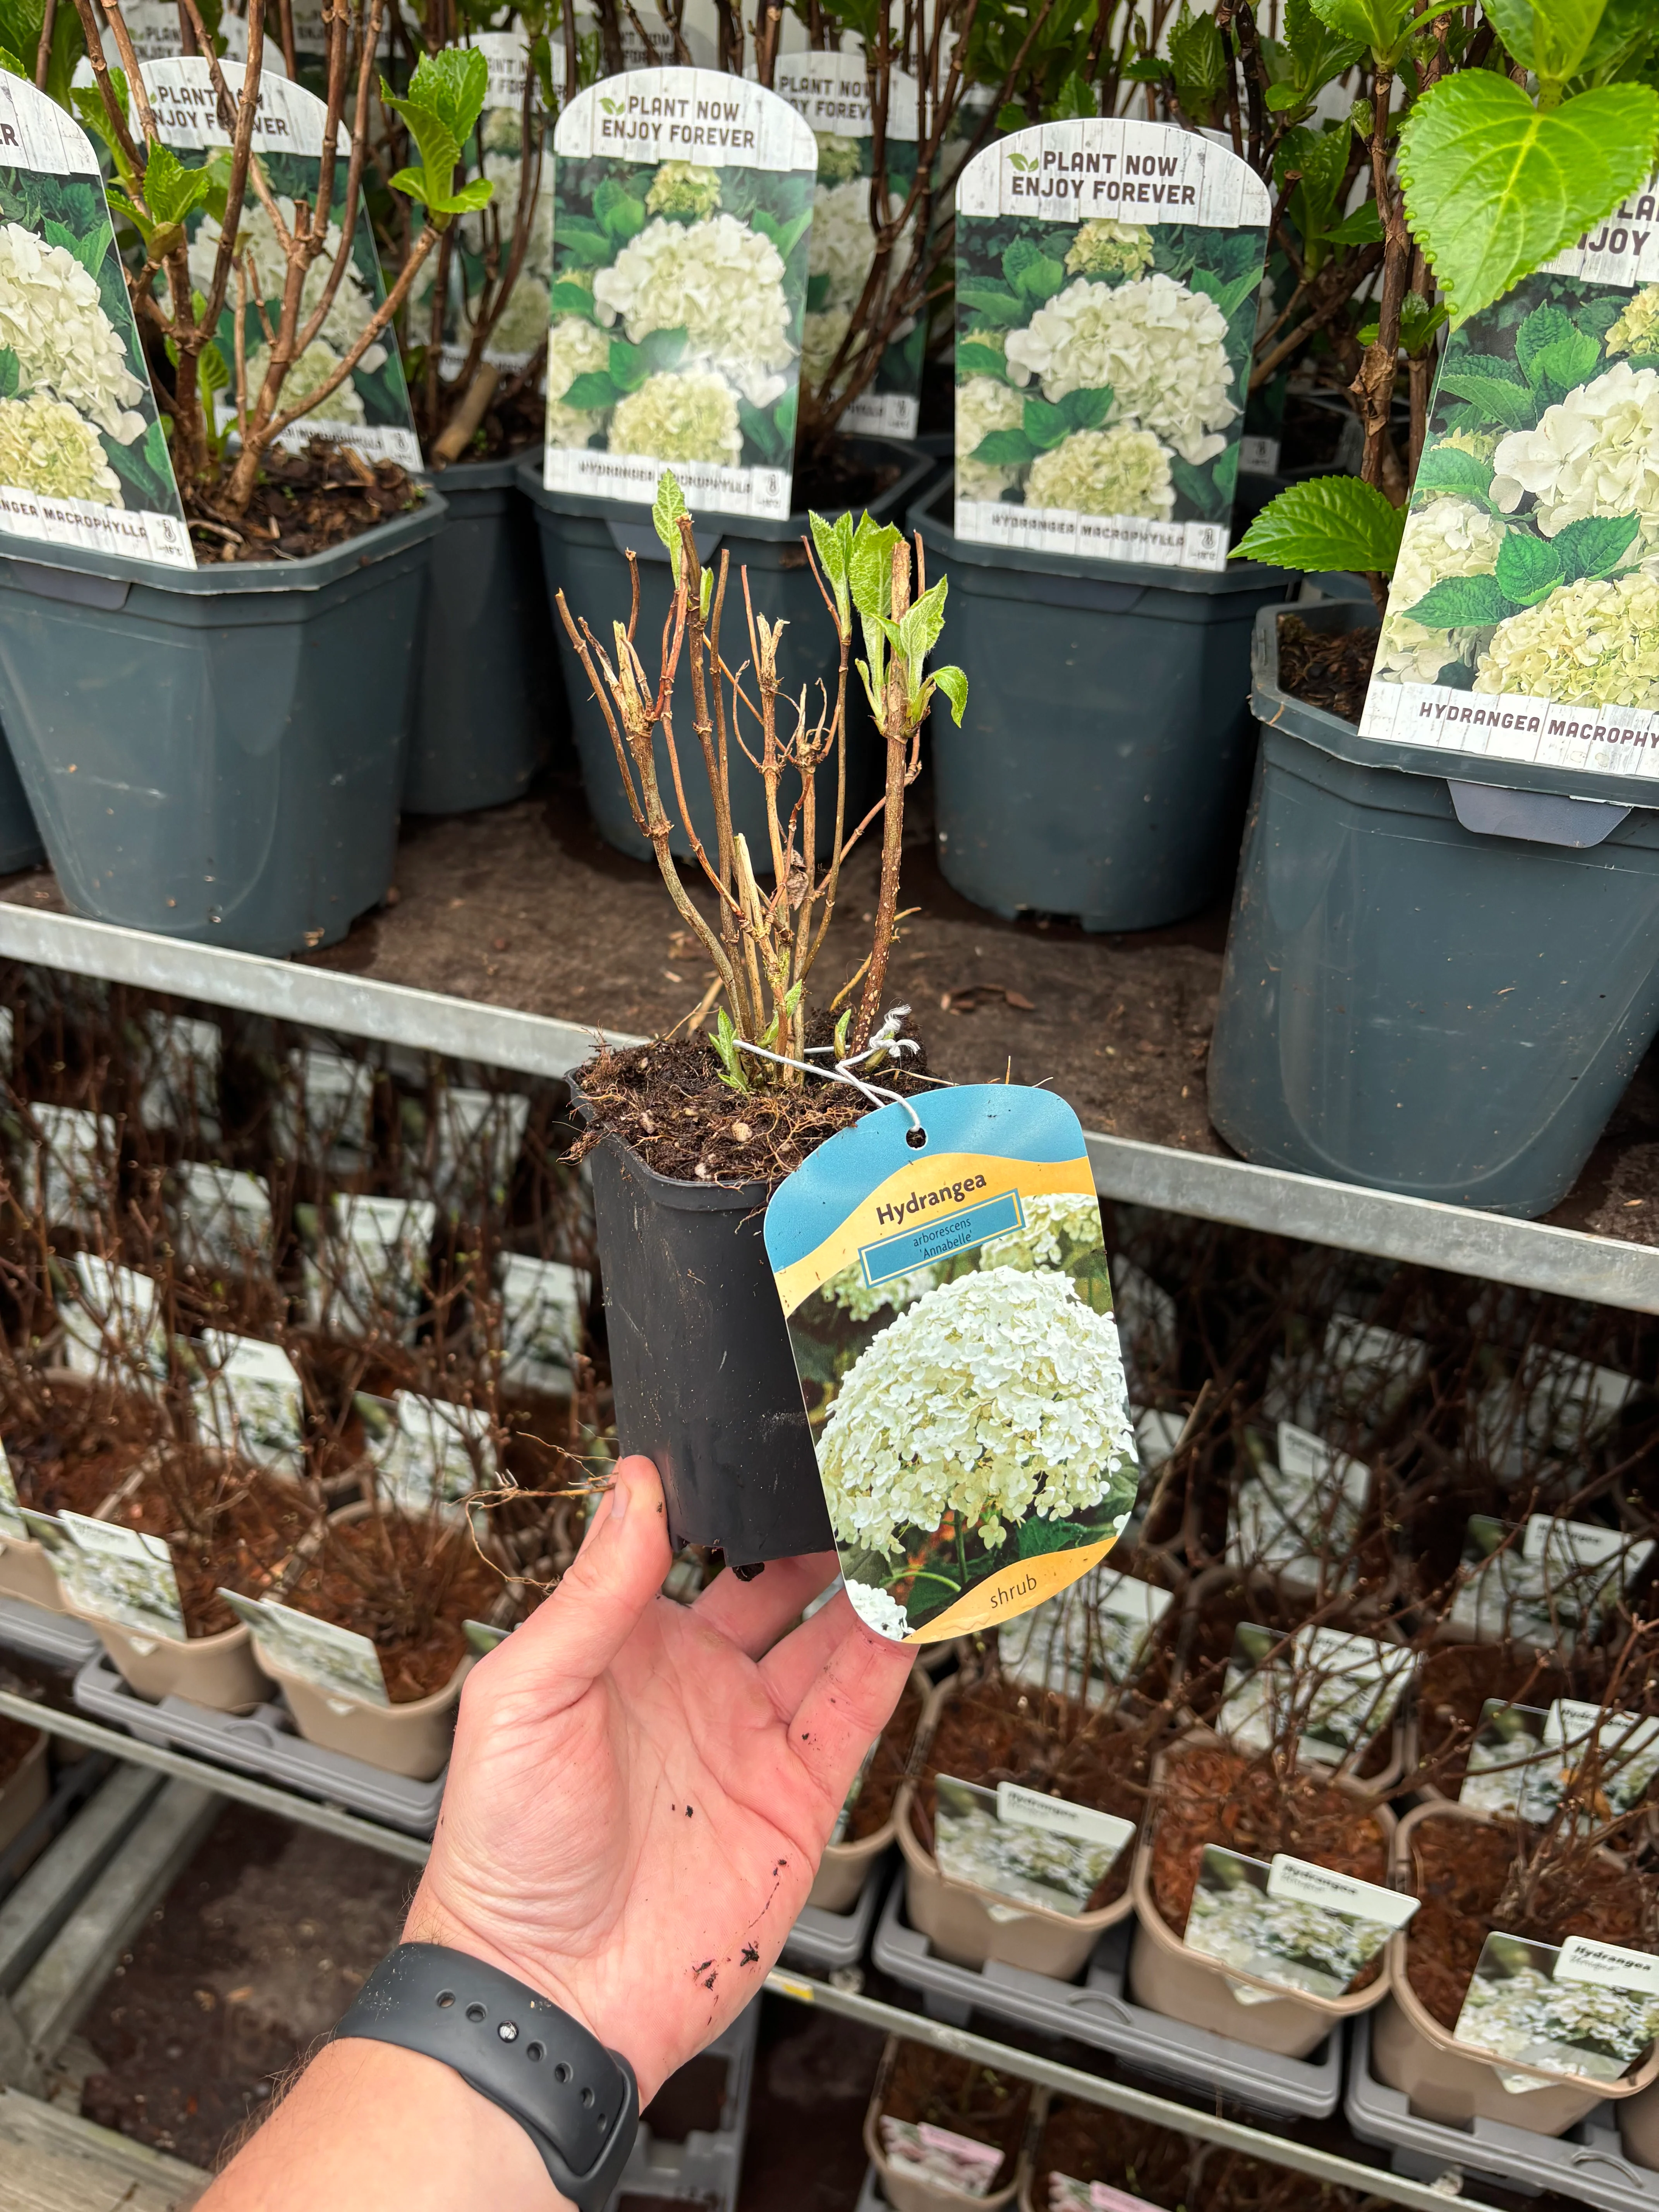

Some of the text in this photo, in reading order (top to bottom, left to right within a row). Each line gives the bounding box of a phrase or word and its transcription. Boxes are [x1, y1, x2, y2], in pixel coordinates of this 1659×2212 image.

[157, 86, 216, 106] PLANT
[779, 76, 834, 95] PLANT
[152, 108, 198, 129] NJOY
[629, 96, 740, 122] PLANT NOW
[816, 100, 871, 119] FOREV
[602, 119, 754, 148] ENJOY FOREVER
[1044, 151, 1178, 177] PLANT NOW
[1012, 176, 1195, 205] ENJOY FOREVER
[43, 507, 148, 538] MACROPHYLLA
[991, 514, 1075, 534] HYDRANGEA
[1419, 702, 1540, 732] HYDRANGEA
[876, 1174, 987, 1225] Hydrangea
[913, 1218, 971, 1247] arborescens
[919, 1230, 972, 1260] 'Annabelle'
[990, 1574, 1037, 1609] shrub
[1574, 1945, 1652, 1970] Hydrangea
